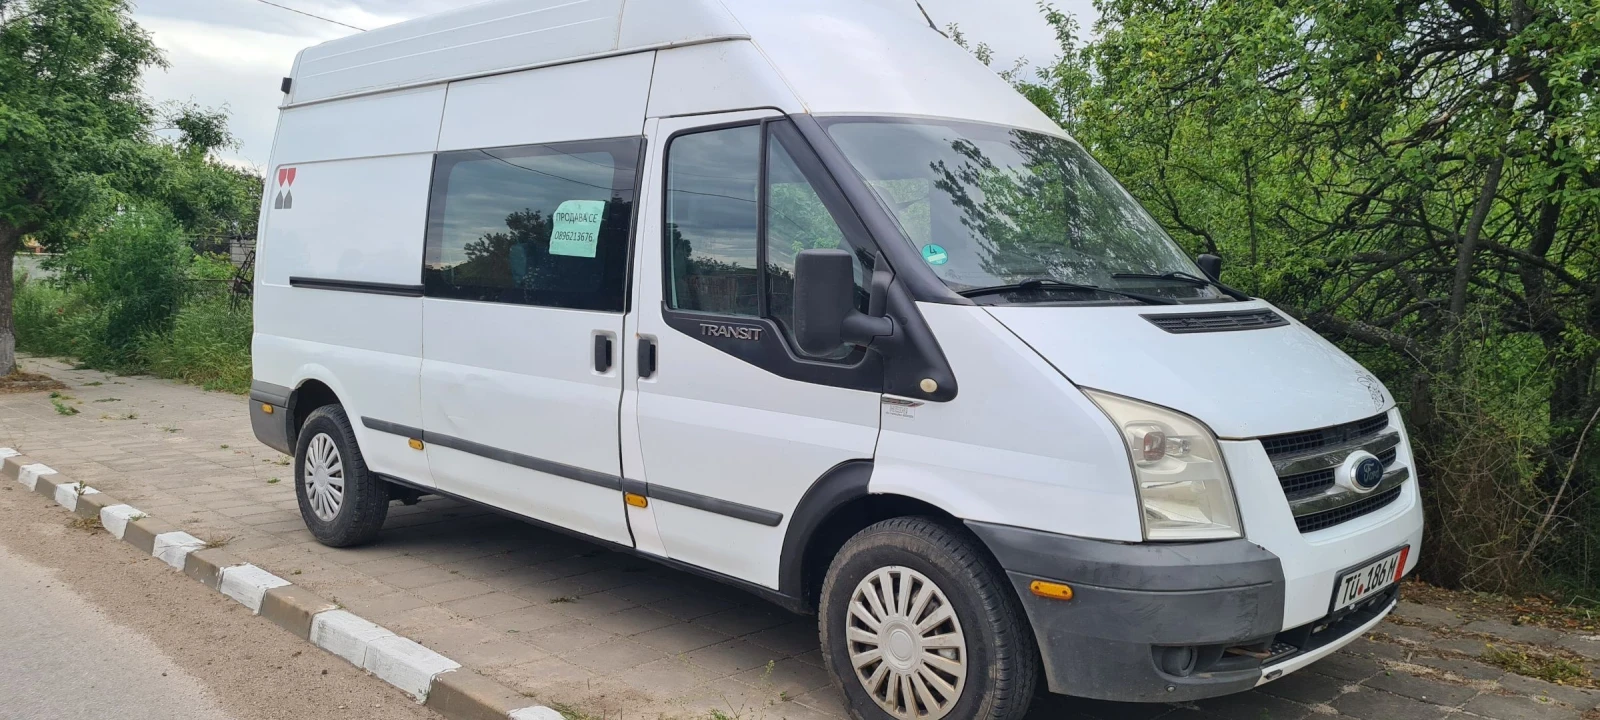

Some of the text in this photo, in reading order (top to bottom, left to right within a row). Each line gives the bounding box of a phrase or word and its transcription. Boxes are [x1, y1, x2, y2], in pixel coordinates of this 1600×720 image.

[556, 212, 599, 224] ПРОДАВА СЕ
[554, 231, 594, 242] 0896213676
[928, 244, 938, 255] 4
[699, 323, 762, 341] TRANSIT
[1363, 462, 1380, 483] Ford
[1363, 560, 1388, 594] 186
